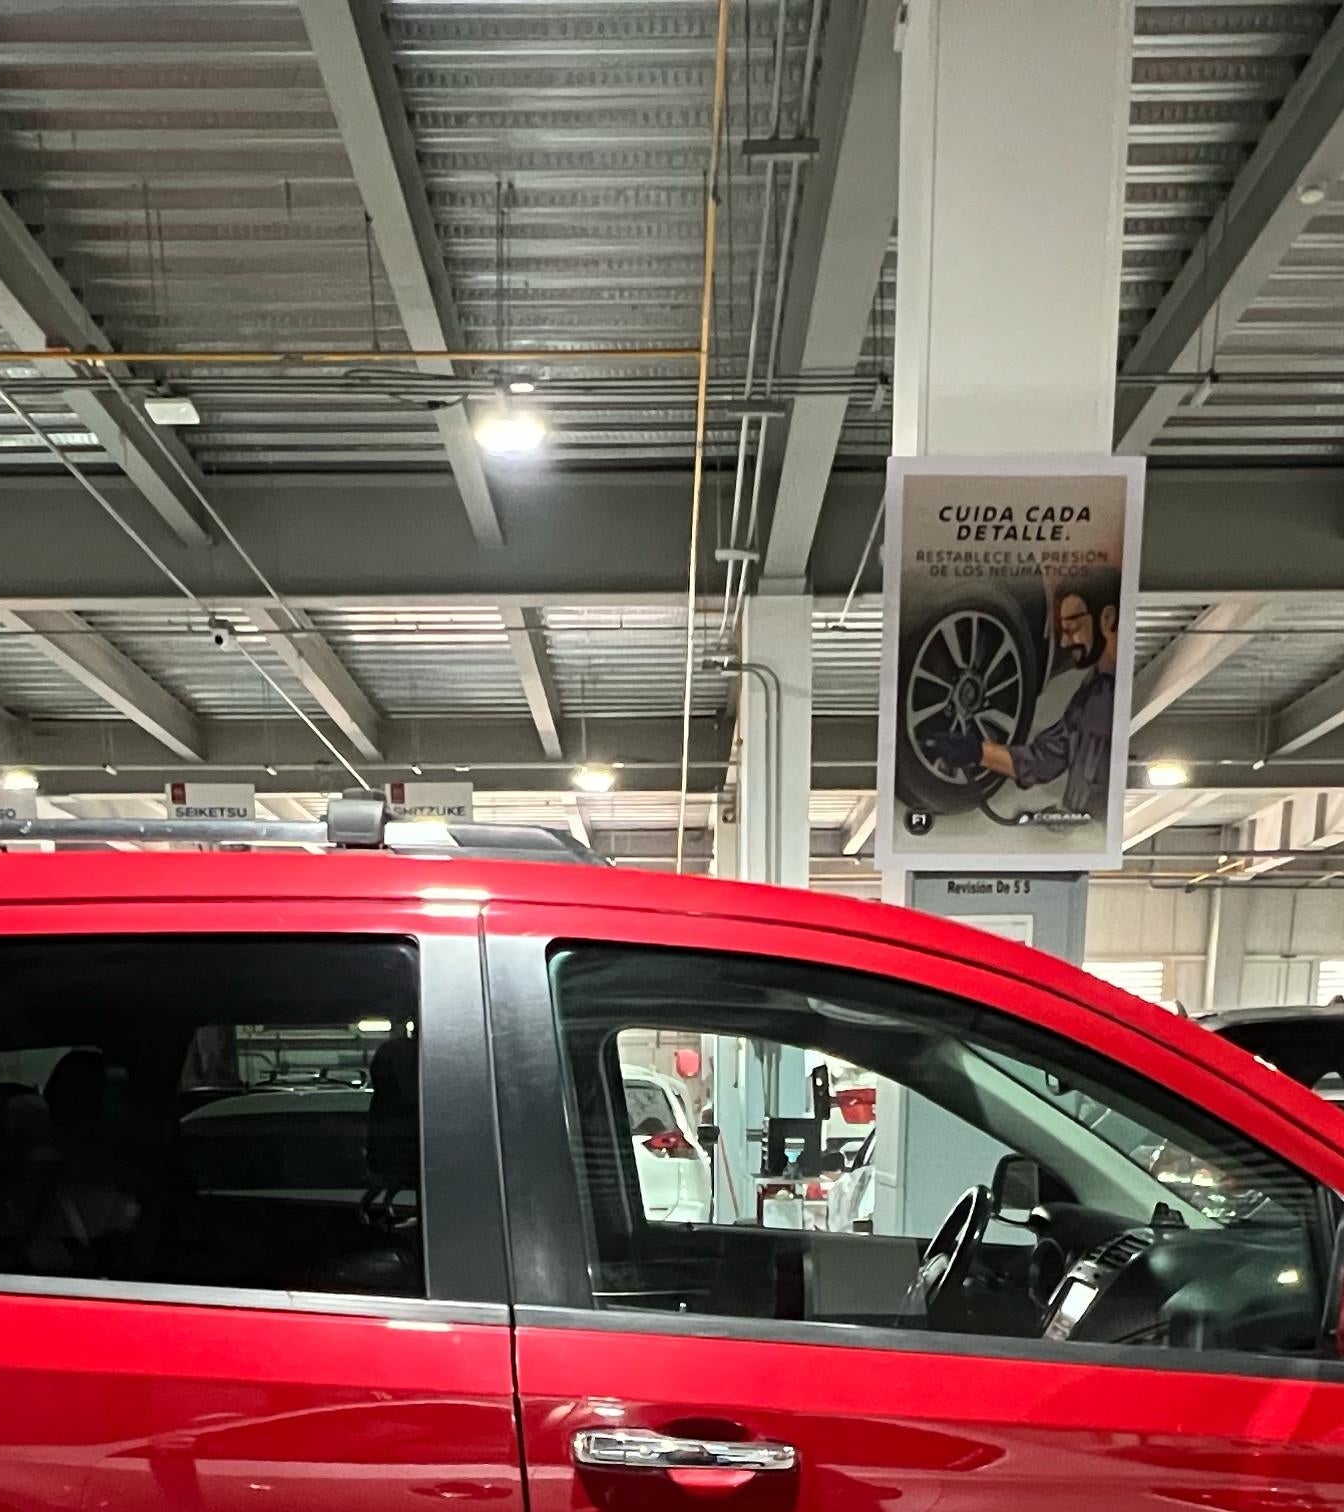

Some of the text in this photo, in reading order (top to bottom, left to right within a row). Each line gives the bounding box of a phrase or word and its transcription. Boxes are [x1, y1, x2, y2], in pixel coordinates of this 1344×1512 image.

[938, 506, 1091, 522] CUIDA CADA
[956, 525, 1071, 541] DETALLE.
[916, 551, 1012, 563] RESTABLECE
[1017, 551, 1035, 563] LA
[929, 565, 947, 577] DE
[954, 565, 983, 577] LOS
[175, 806, 248, 818] SEIKETSU
